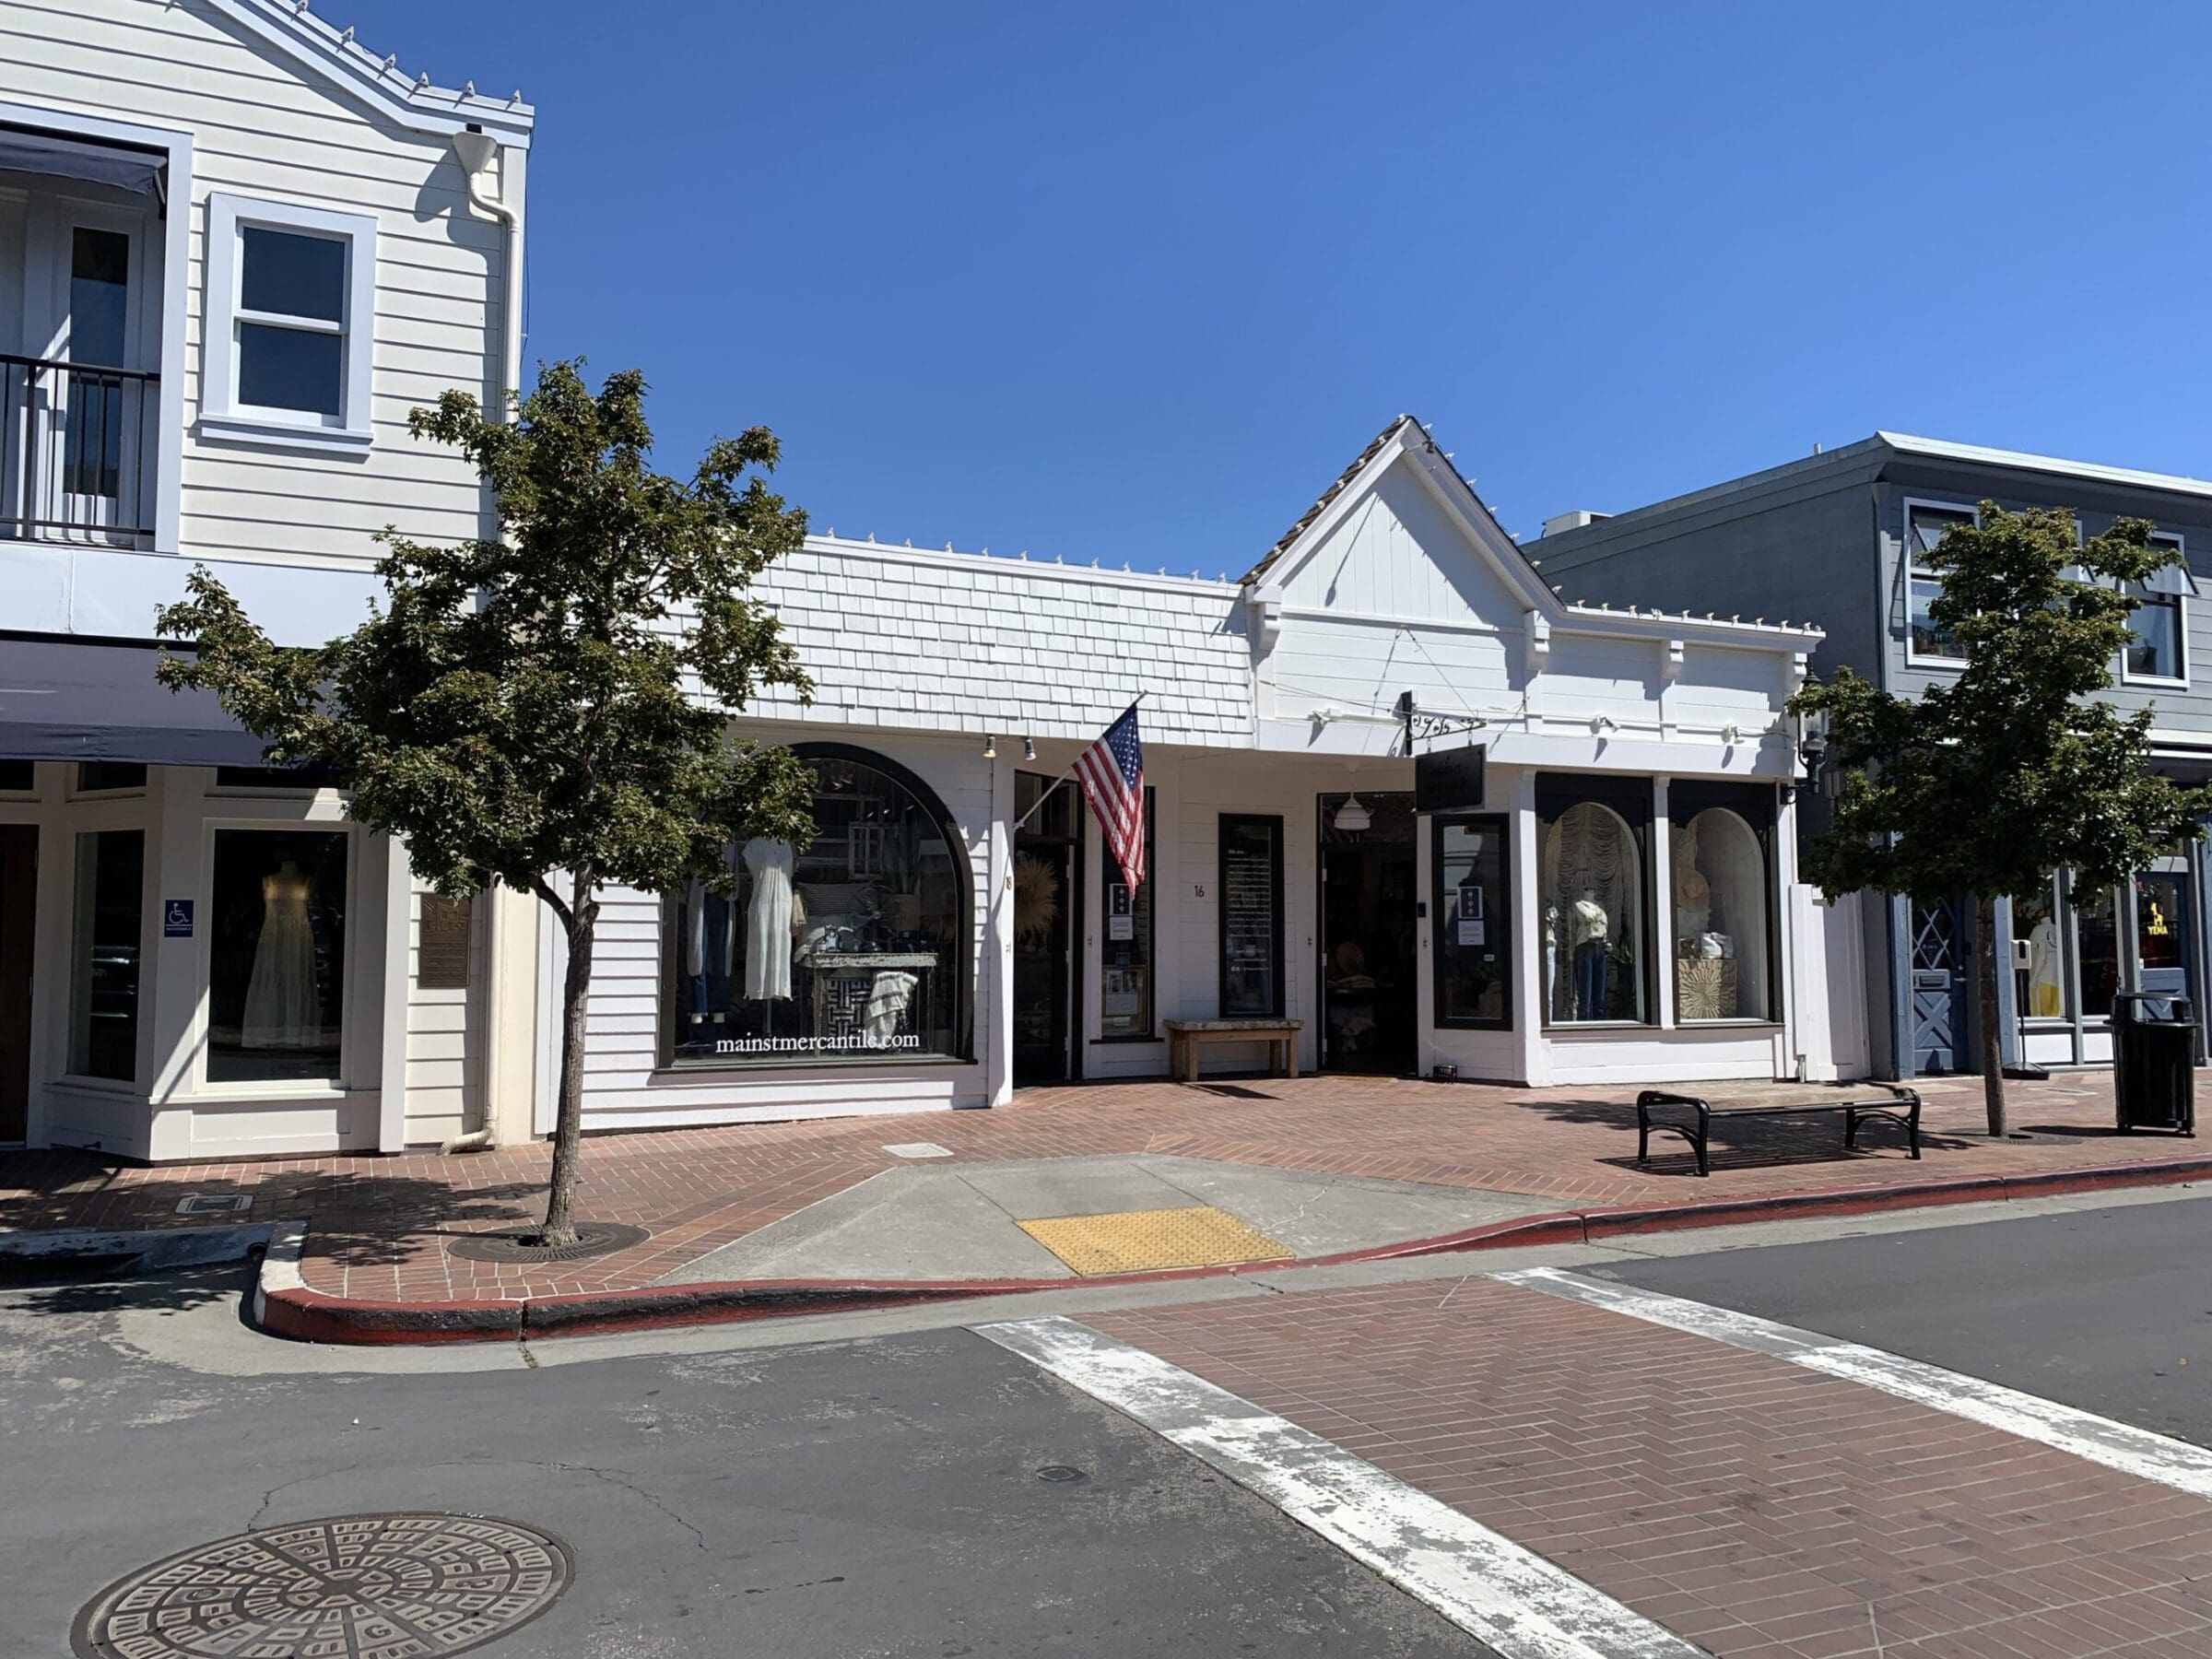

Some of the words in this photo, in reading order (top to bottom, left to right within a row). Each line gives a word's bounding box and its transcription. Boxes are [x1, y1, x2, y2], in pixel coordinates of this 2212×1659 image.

[1194, 885, 1204, 898] 16
[2147, 925, 2168, 935] YEMA
[715, 1029, 920, 1053] mainstmercantile.com
